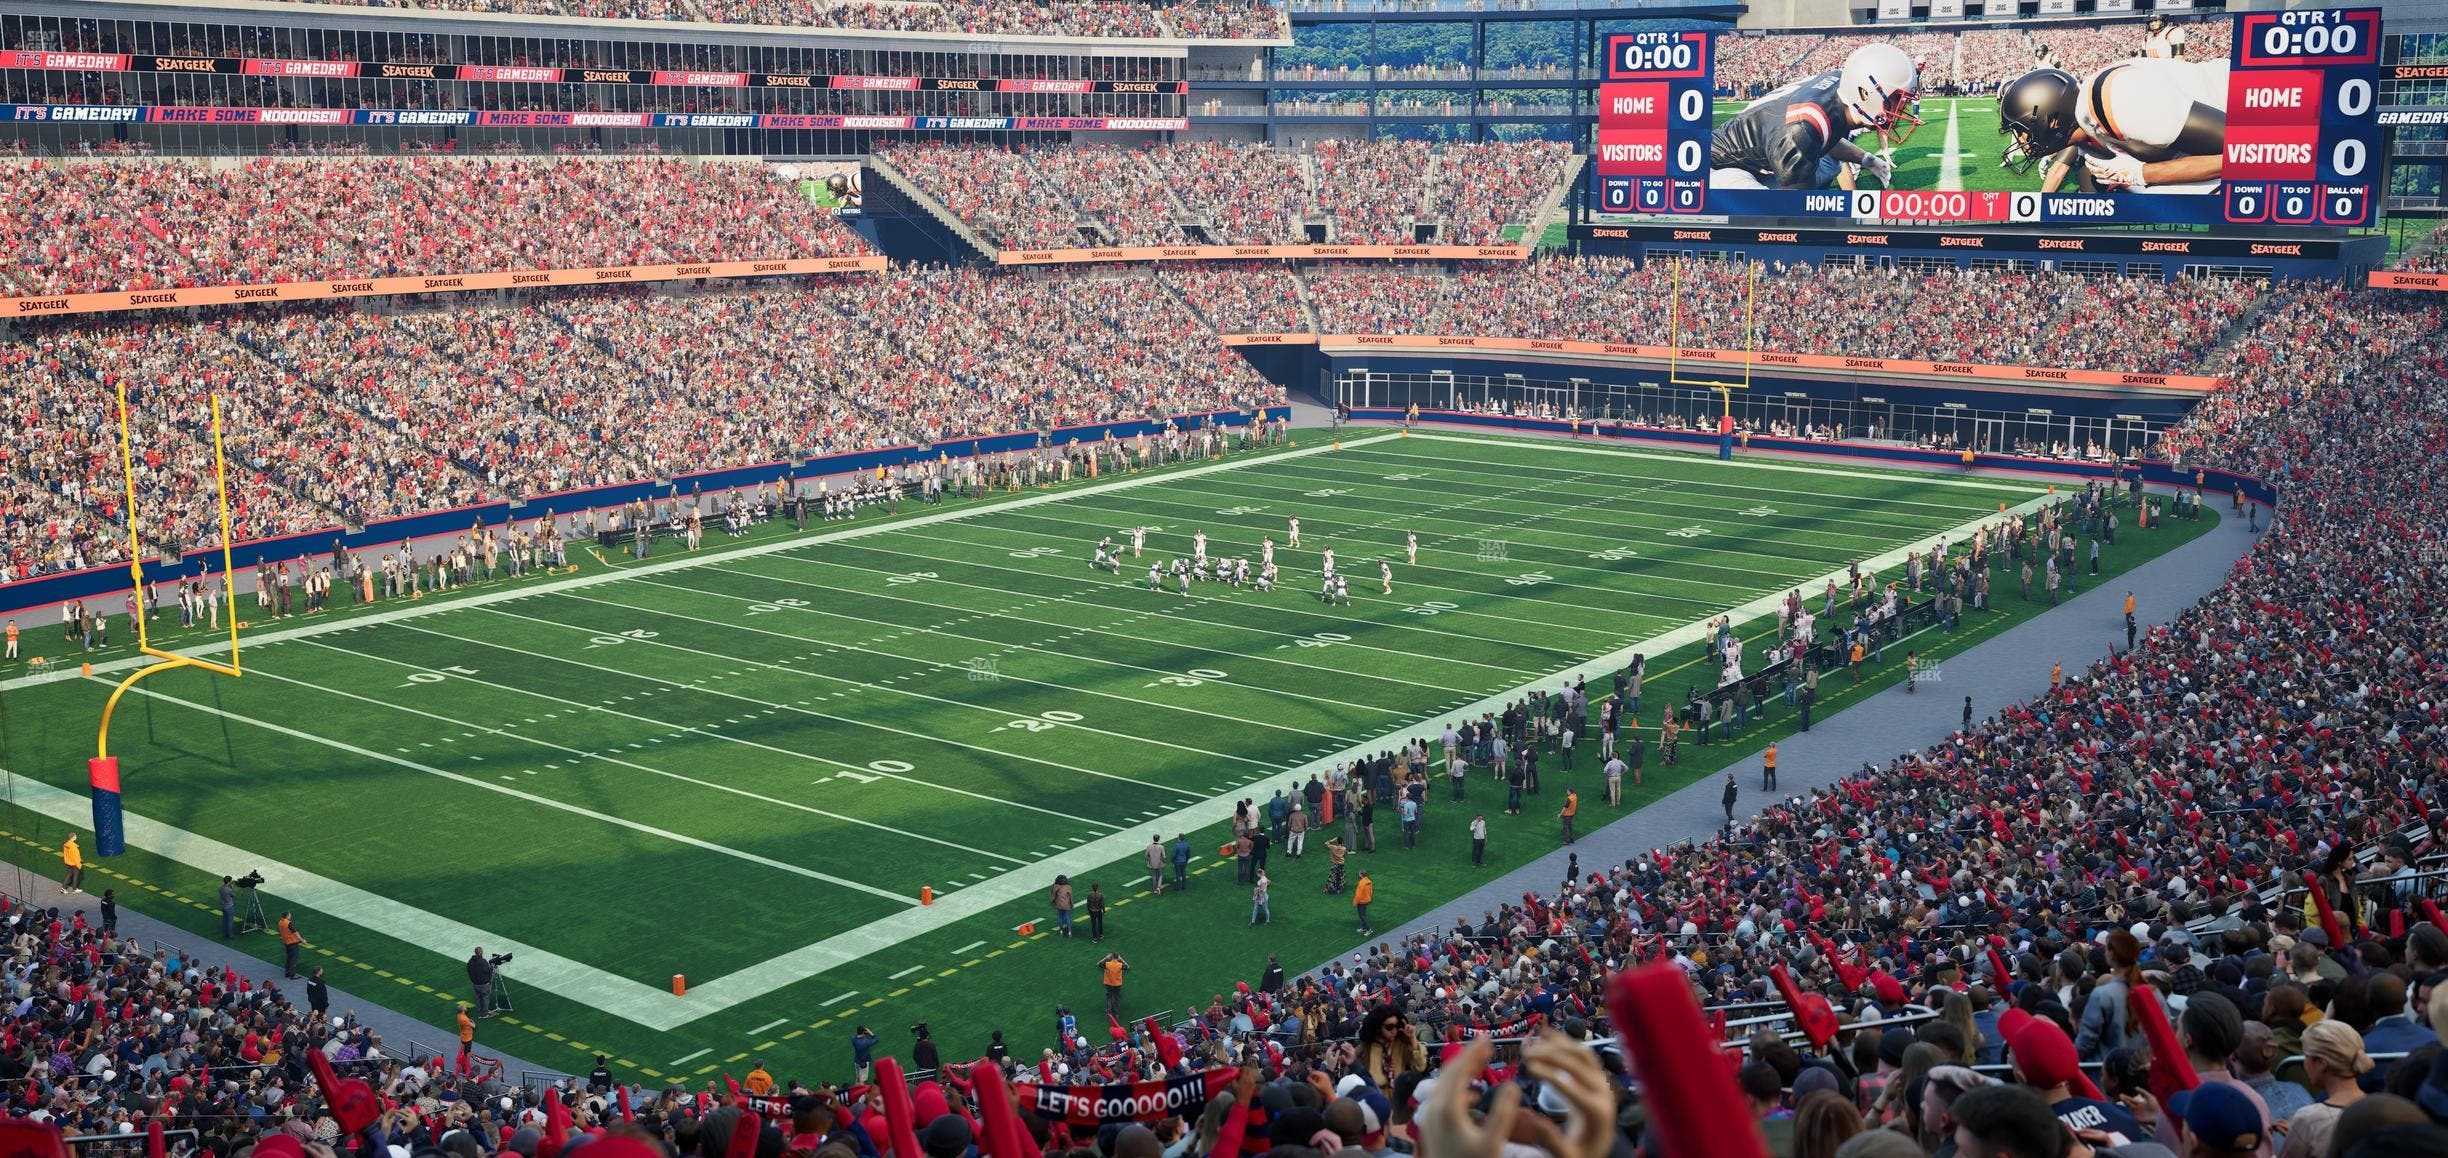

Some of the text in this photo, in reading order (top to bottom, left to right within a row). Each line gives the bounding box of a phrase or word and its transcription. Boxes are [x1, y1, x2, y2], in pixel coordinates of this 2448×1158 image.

[2282, 10, 2341, 25] QTR 1
[1637, 32, 1679, 44] QTR 1
[2265, 25, 2357, 54] 0:00
[15, 54, 117, 68] IT'S GAMEDAY!
[1626, 45, 1691, 69] 0:00
[156, 58, 216, 72] SEATGEEK
[259, 62, 348, 74] IT'S GAMEDAY!
[383, 65, 434, 78] SEATGEEK
[472, 68, 553, 80] IT'S GAMEDAY!
[584, 71, 630, 82] SEATGEEK
[666, 74, 738, 84] IT'S GAMEDAY!
[767, 76, 810, 86] SEATGEEK
[842, 78, 911, 88] IT'S GAMEDAY!
[938, 80, 978, 90] SEATGEEK
[1010, 81, 1084, 91] IT'S GAMEDAY!
[1113, 83, 1157, 92] SEATGEEK
[2245, 79, 2371, 115] HOME 0
[1614, 90, 1704, 121] HOME 0
[14, 106, 137, 120] IT'S GAMEDAY!
[162, 110, 208, 120] MAKE
[215, 110, 256, 123] SOME
[368, 112, 469, 124] IT'S GAMEDAY!
[490, 114, 528, 124] MAKE
[535, 114, 569, 124] SOME
[664, 116, 752, 126] IT'S GAMEDAY!
[770, 117, 804, 126] MAKE
[810, 118, 840, 126] SOME
[926, 118, 1007, 128] IT'S GAMEDAY!
[1026, 120, 1063, 128] MAKE
[1068, 120, 1103, 128] SOME
[1602, 140, 1701, 172] VISITORS 0
[2228, 139, 2366, 176] VISITORS 0
[1612, 189, 1624, 204] 0
[1647, 190, 1658, 205] 0
[1681, 190, 1693, 205] 0
[1806, 194, 1966, 216] HOME 0 00:00
[1987, 202, 1994, 217] 1
[2017, 196, 2115, 216] 0 VISITORS
[2239, 197, 2255, 215] 0
[2287, 197, 2303, 215] 0
[2335, 197, 2352, 216] 0
[1593, 229, 1628, 238] SEATGEEK
[1674, 231, 1710, 240] SEATGEEK
[1758, 233, 1797, 242] SEATGEEK
[1848, 235, 1888, 244] SEATGEEK
[1941, 237, 1983, 247] SEATGEEK
[2039, 239, 2083, 249] SEATGEEK
[2142, 242, 2189, 252] SEATGEEK
[2251, 244, 2300, 255] SEATGEEK
[754, 263, 786, 272] SEATGEEK
[829, 260, 860, 268] SEATGEEK
[596, 270, 631, 279] SEATGEEK
[677, 266, 711, 275] SEATGEEK
[425, 278, 463, 288] SEATGEEK
[513, 274, 549, 284] SEATGEEK
[2394, 276, 2438, 286] SEATGEEK
[235, 288, 278, 298] SEATGEEK
[332, 282, 373, 293] SEATGEEK
[20, 299, 69, 311] SEATGEEK
[130, 293, 176, 305] SEATGEEK
[1531, 342, 1562, 350] SEATGEEK
[1605, 346, 1637, 354] SEATGEEK
[1681, 350, 1716, 358] SEATGEEK
[1762, 354, 1797, 363] SEATGEEK
[1846, 359, 1883, 368] SEATGEEK
[1934, 364, 1973, 374] SEATGEEK
[2026, 370, 2067, 379] SEATGEEK
[2122, 375, 2166, 385] SEATGEEK
[1504, 573, 1553, 585] 40
[748, 598, 811, 612] 30
[1401, 601, 1459, 615] 50
[590, 629, 660, 645] 20
[1295, 632, 1352, 648] 40
[407, 665, 480, 683] 10
[1159, 668, 1228, 687] 30
[1008, 711, 1084, 732] 20
[834, 760, 915, 783] 10
[1037, 1078, 1204, 1118] LET'S GOOOOO!!!
[748, 1097, 780, 1115] LET'S
